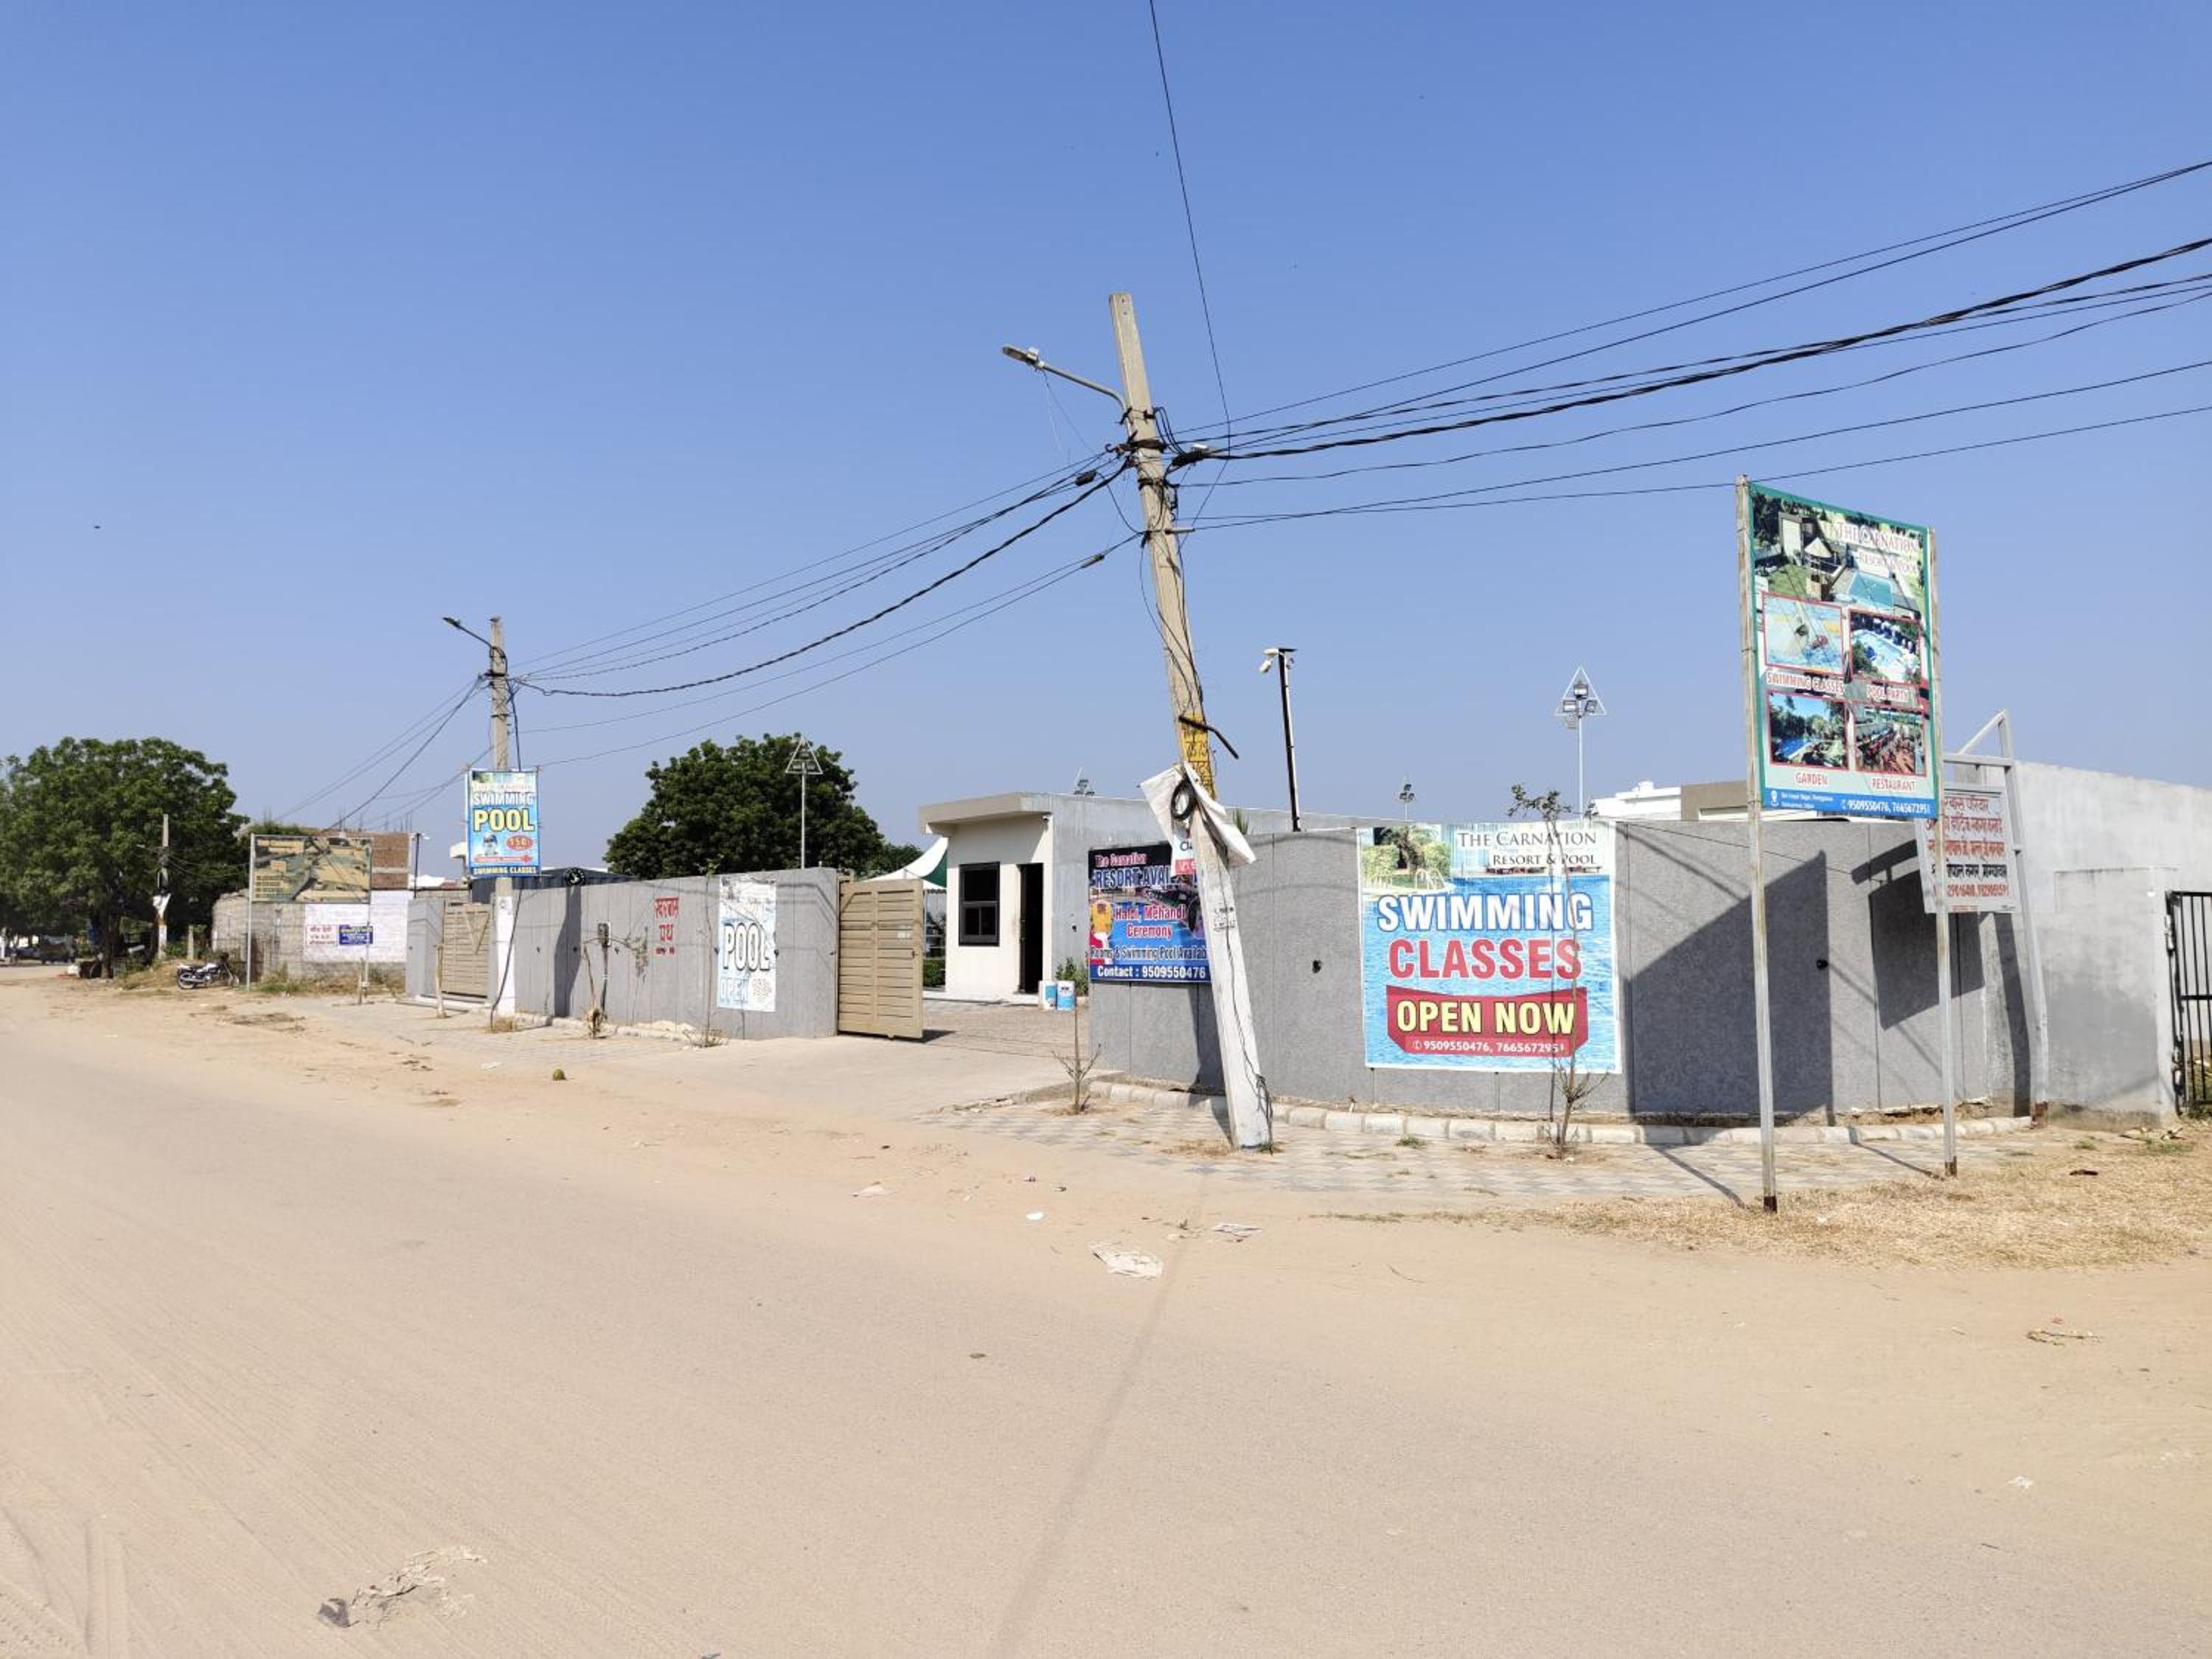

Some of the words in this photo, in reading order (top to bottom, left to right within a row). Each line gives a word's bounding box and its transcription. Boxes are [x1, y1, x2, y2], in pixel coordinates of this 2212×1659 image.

[1796, 773, 1829, 787] GARDEN
[1872, 777, 1916, 791] RESTAURANT
[473, 808, 535, 832] POOL
[1458, 832, 1490, 847] THE
[1496, 831, 1596, 846] CARNATION
[1492, 855, 1540, 865] RESORT
[1094, 868, 1141, 889] RESORT
[1377, 893, 1593, 932] SWIMMING
[1126, 922, 1173, 942] Ceremony
[723, 922, 770, 972] POOL
[1388, 939, 1582, 979] CLASSES
[1097, 965, 1133, 978] Contact
[1142, 964, 1206, 978] 9509550476
[1397, 1001, 1481, 1034] OPEN
[1494, 1001, 1574, 1034] NOW
